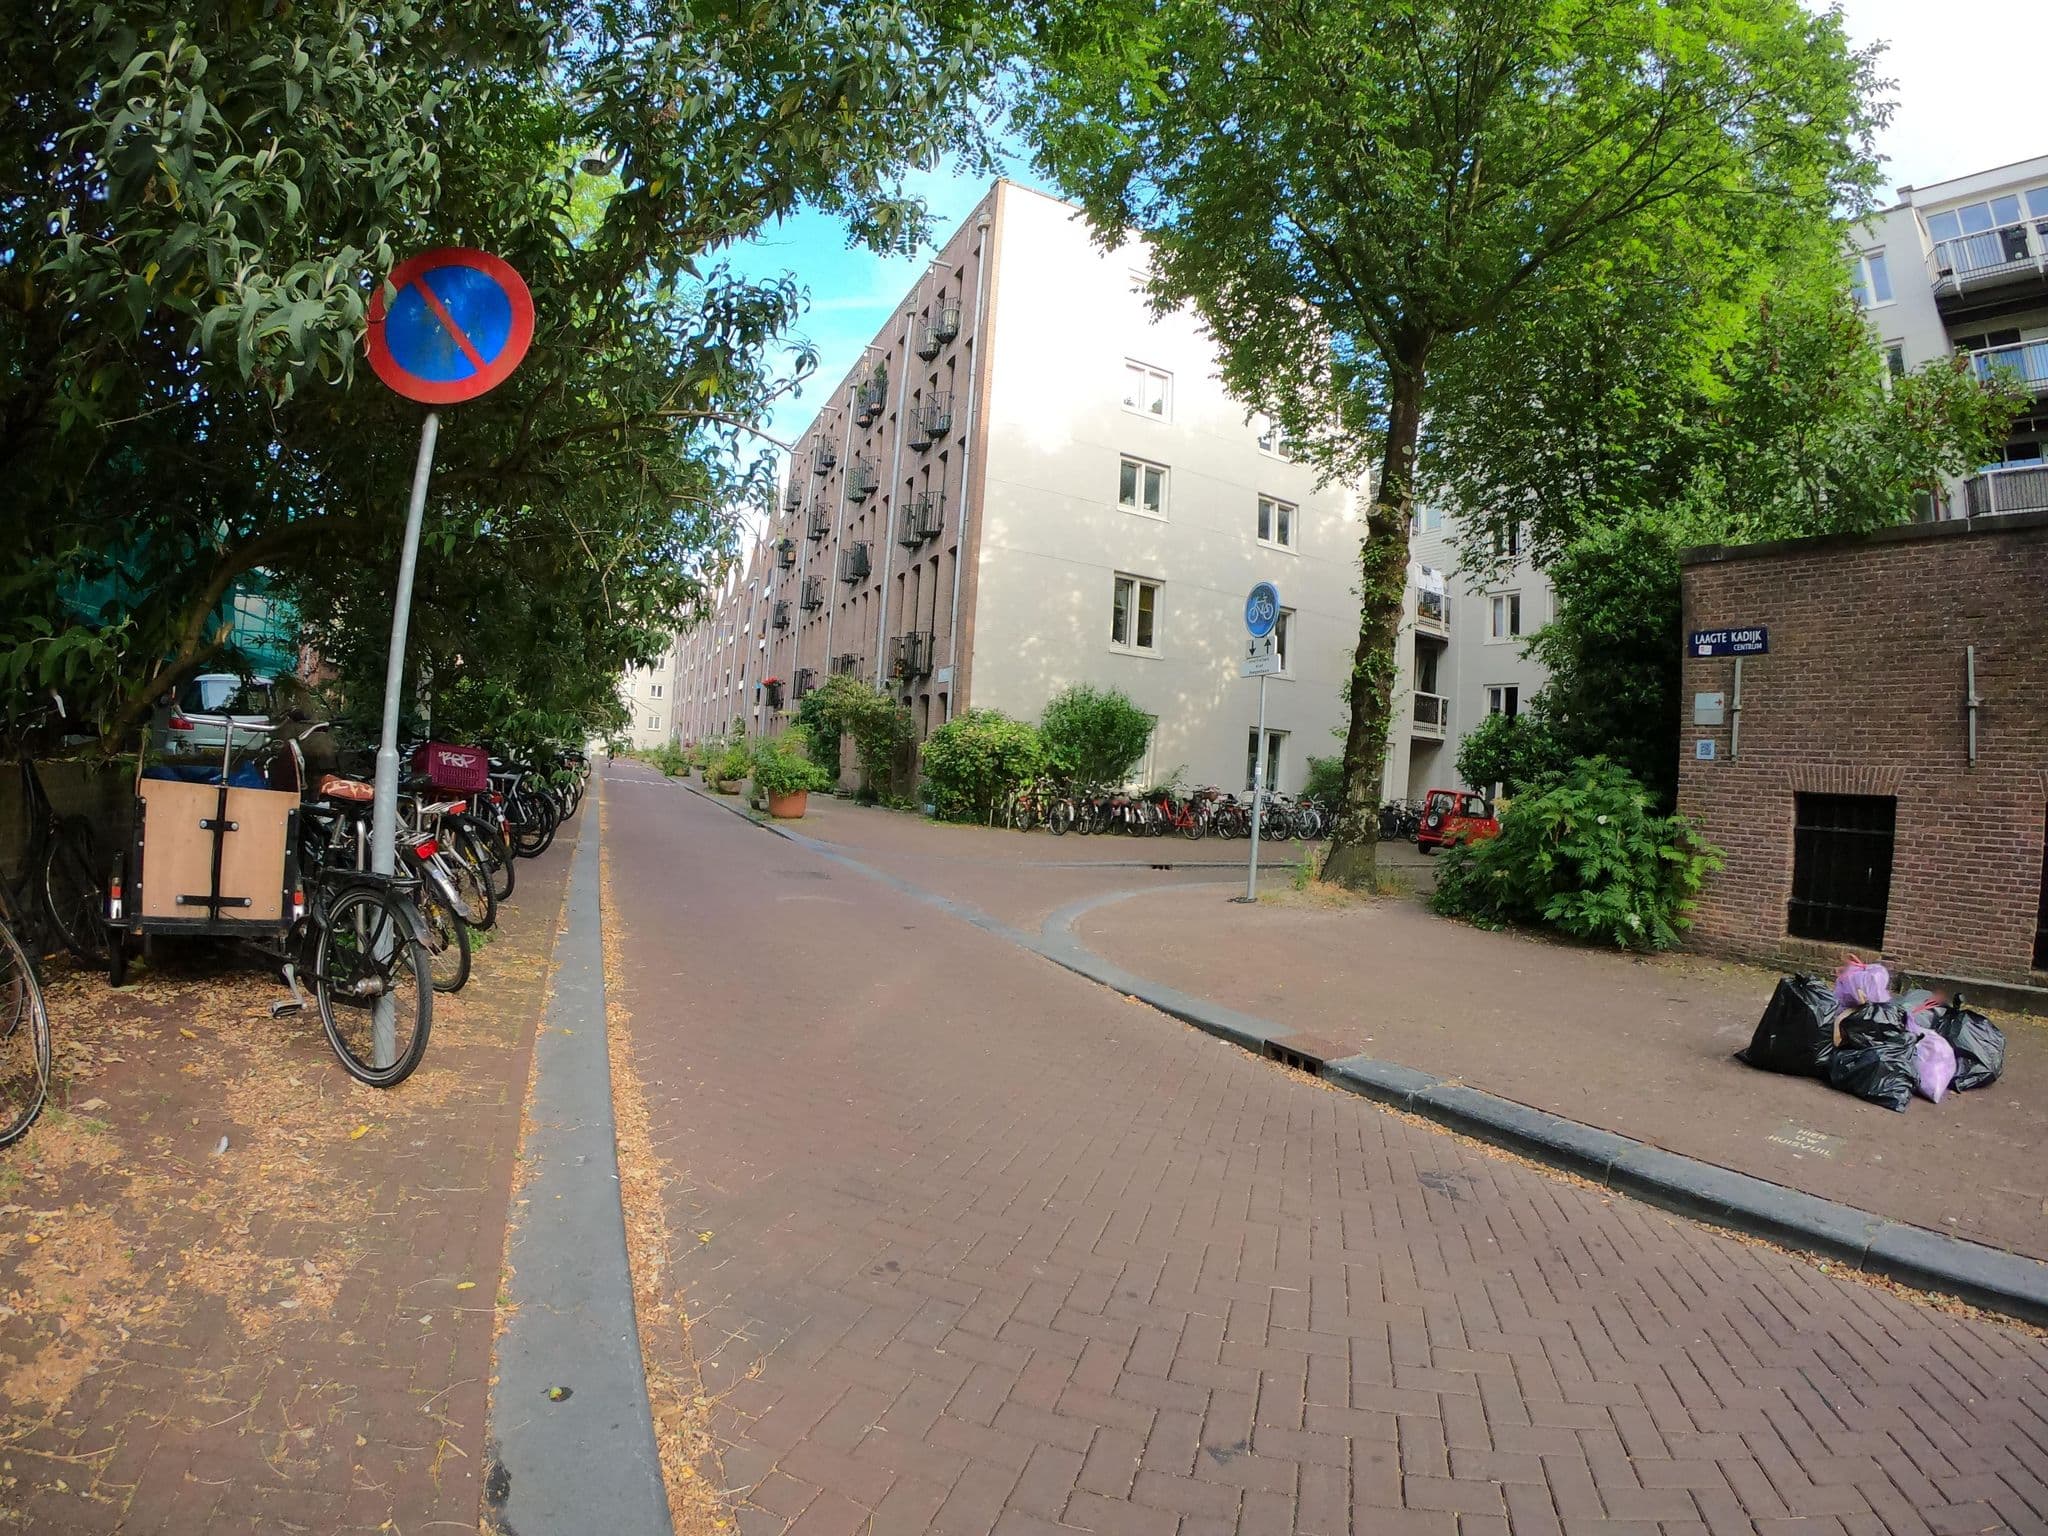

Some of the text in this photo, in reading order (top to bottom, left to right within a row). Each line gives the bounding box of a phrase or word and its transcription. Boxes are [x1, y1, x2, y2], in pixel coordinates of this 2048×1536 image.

[1695, 630, 1762, 644] LAAGTE KADIJK
[1733, 643, 1762, 651] CENTRUM
[1797, 1129, 1828, 1141] HIER
[1764, 1134, 1832, 1156] HUISVUIL
